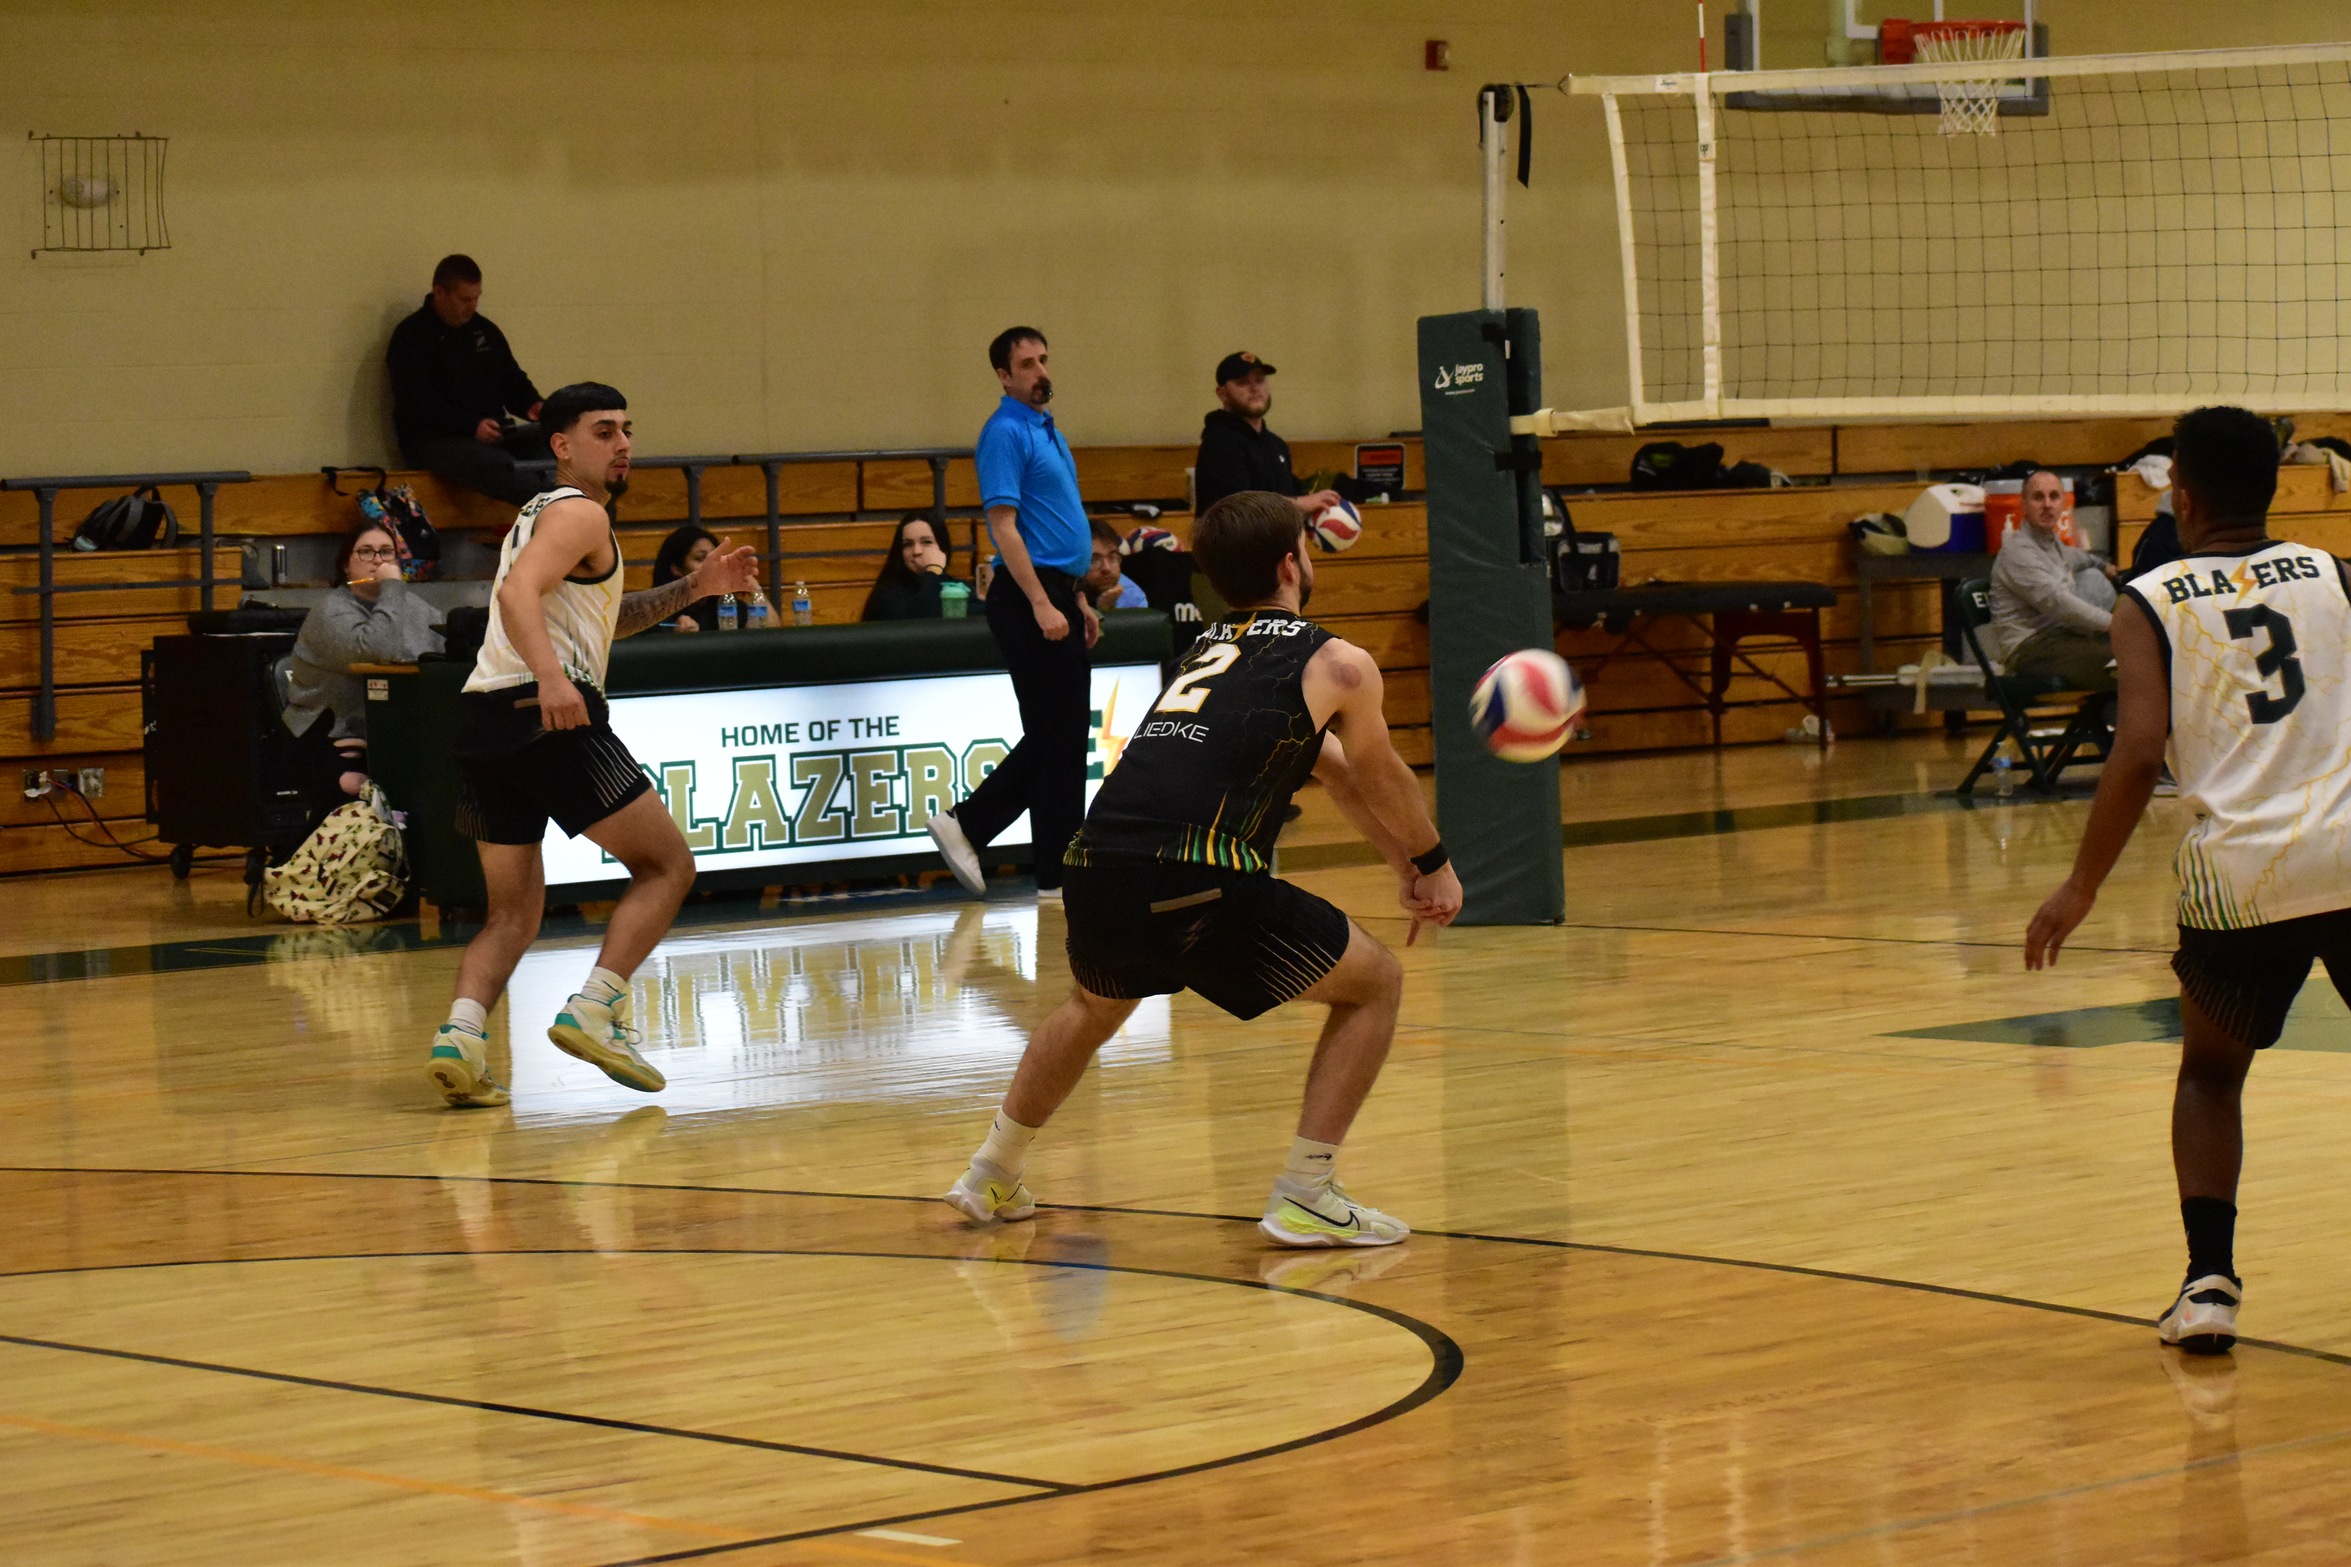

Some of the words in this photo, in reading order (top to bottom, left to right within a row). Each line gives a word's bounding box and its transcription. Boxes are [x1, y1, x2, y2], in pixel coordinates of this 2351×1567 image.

[1455, 373, 1484, 385] sports
[1153, 642, 1242, 714] 2
[2223, 603, 2306, 725] 3
[721, 722, 800, 748] HOME
[808, 719, 841, 742] OF
[848, 715, 900, 739] THE
[1133, 721, 1210, 743] LIEDKE
